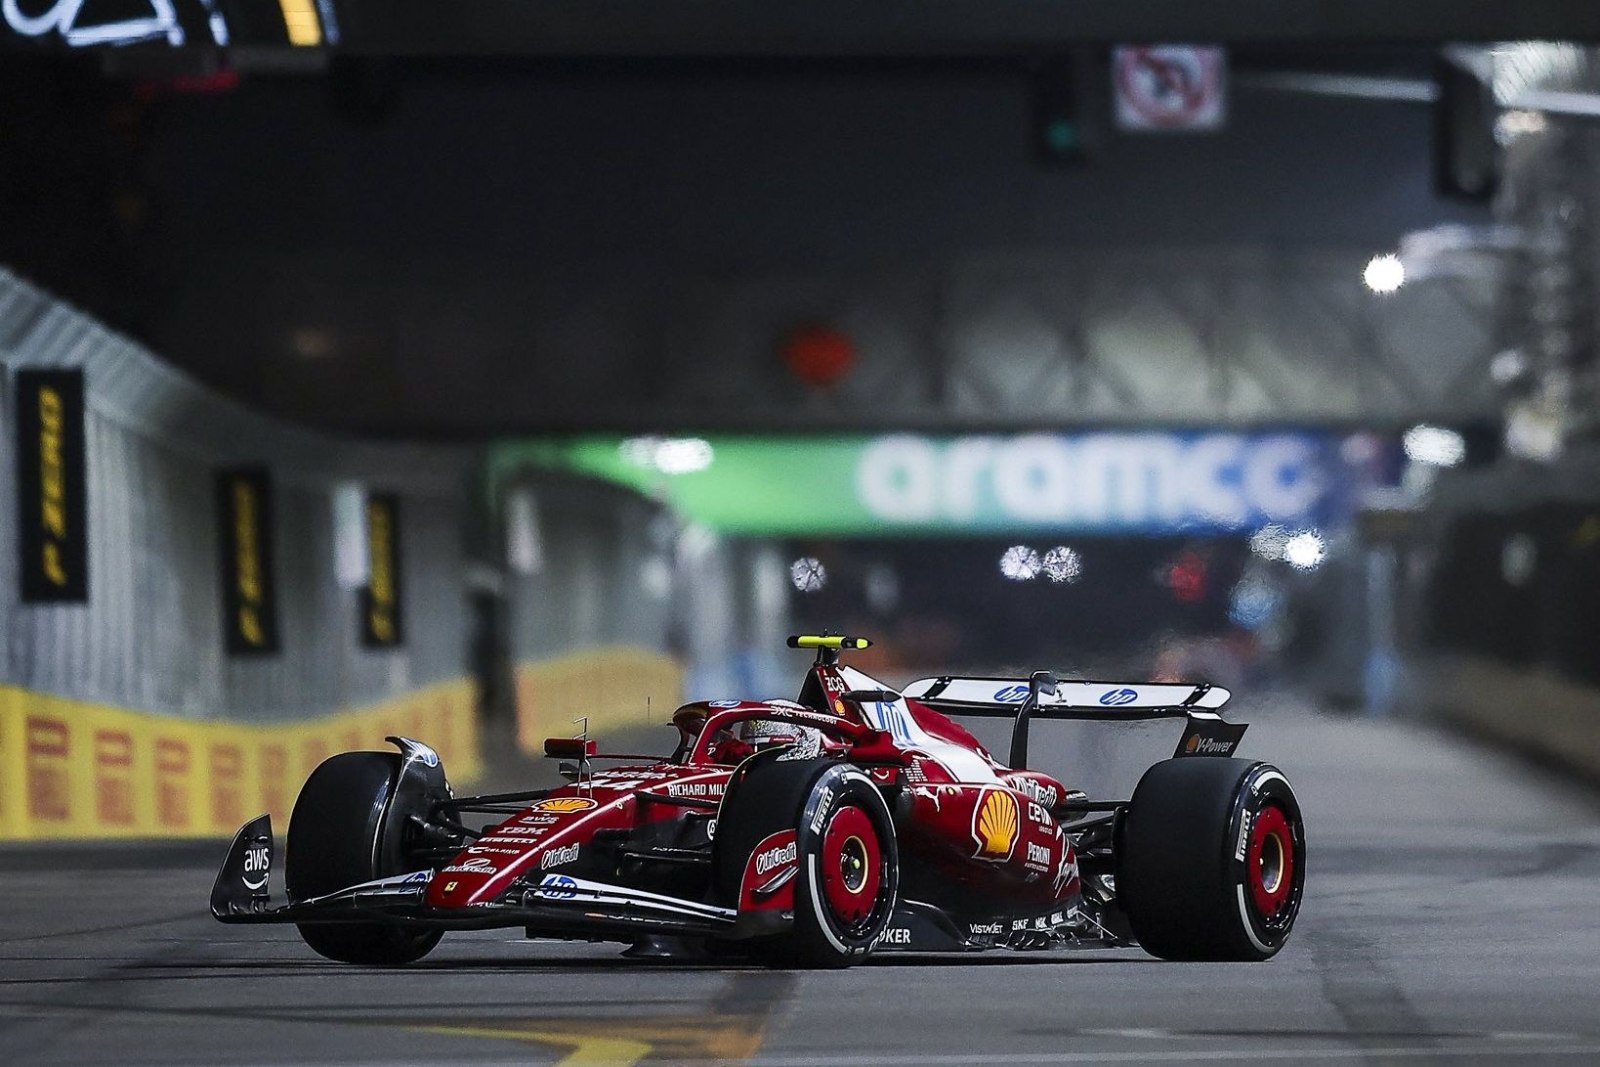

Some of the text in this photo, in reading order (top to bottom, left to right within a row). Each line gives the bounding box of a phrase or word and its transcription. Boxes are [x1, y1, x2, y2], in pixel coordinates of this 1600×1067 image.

[858, 433, 1316, 523] aramco
[998, 686, 1028, 702] hp
[1103, 688, 1135, 705] hp
[770, 705, 838, 725] DXC TECHNOLOGY
[1196, 738, 1233, 753] V-Power
[668, 783, 727, 797] RICHARD MIL
[810, 786, 834, 835] PIRELLI
[497, 826, 548, 834] IBM
[1235, 808, 1251, 862] PIRELLI
[244, 848, 269, 872] aws
[547, 876, 577, 898] hp
[1012, 918, 1029, 931] SKF
